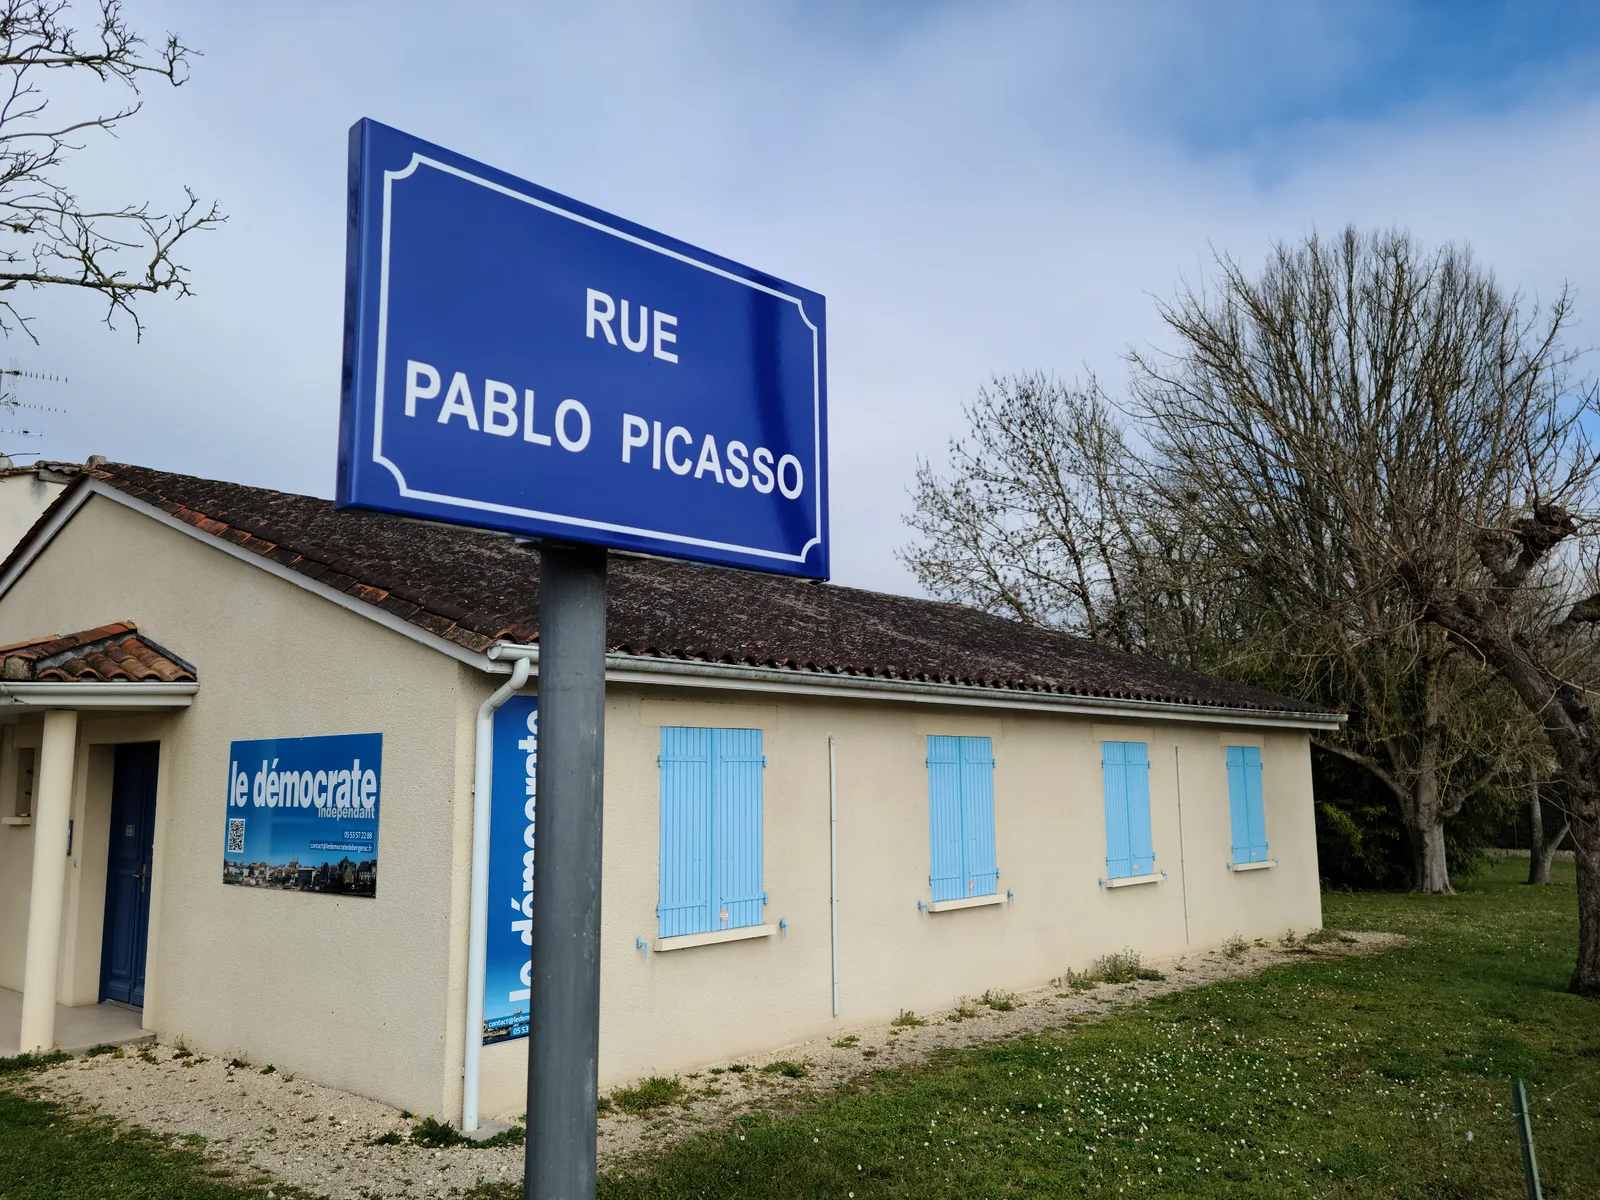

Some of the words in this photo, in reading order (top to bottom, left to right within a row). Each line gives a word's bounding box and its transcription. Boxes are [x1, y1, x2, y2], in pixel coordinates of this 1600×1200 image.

[586, 287, 678, 364] RUE
[404, 360, 591, 453] PABLO
[622, 413, 804, 500] PICASSO
[230, 761, 248, 807] le
[254, 758, 376, 808] démocrate
[318, 805, 375, 821] indépendant
